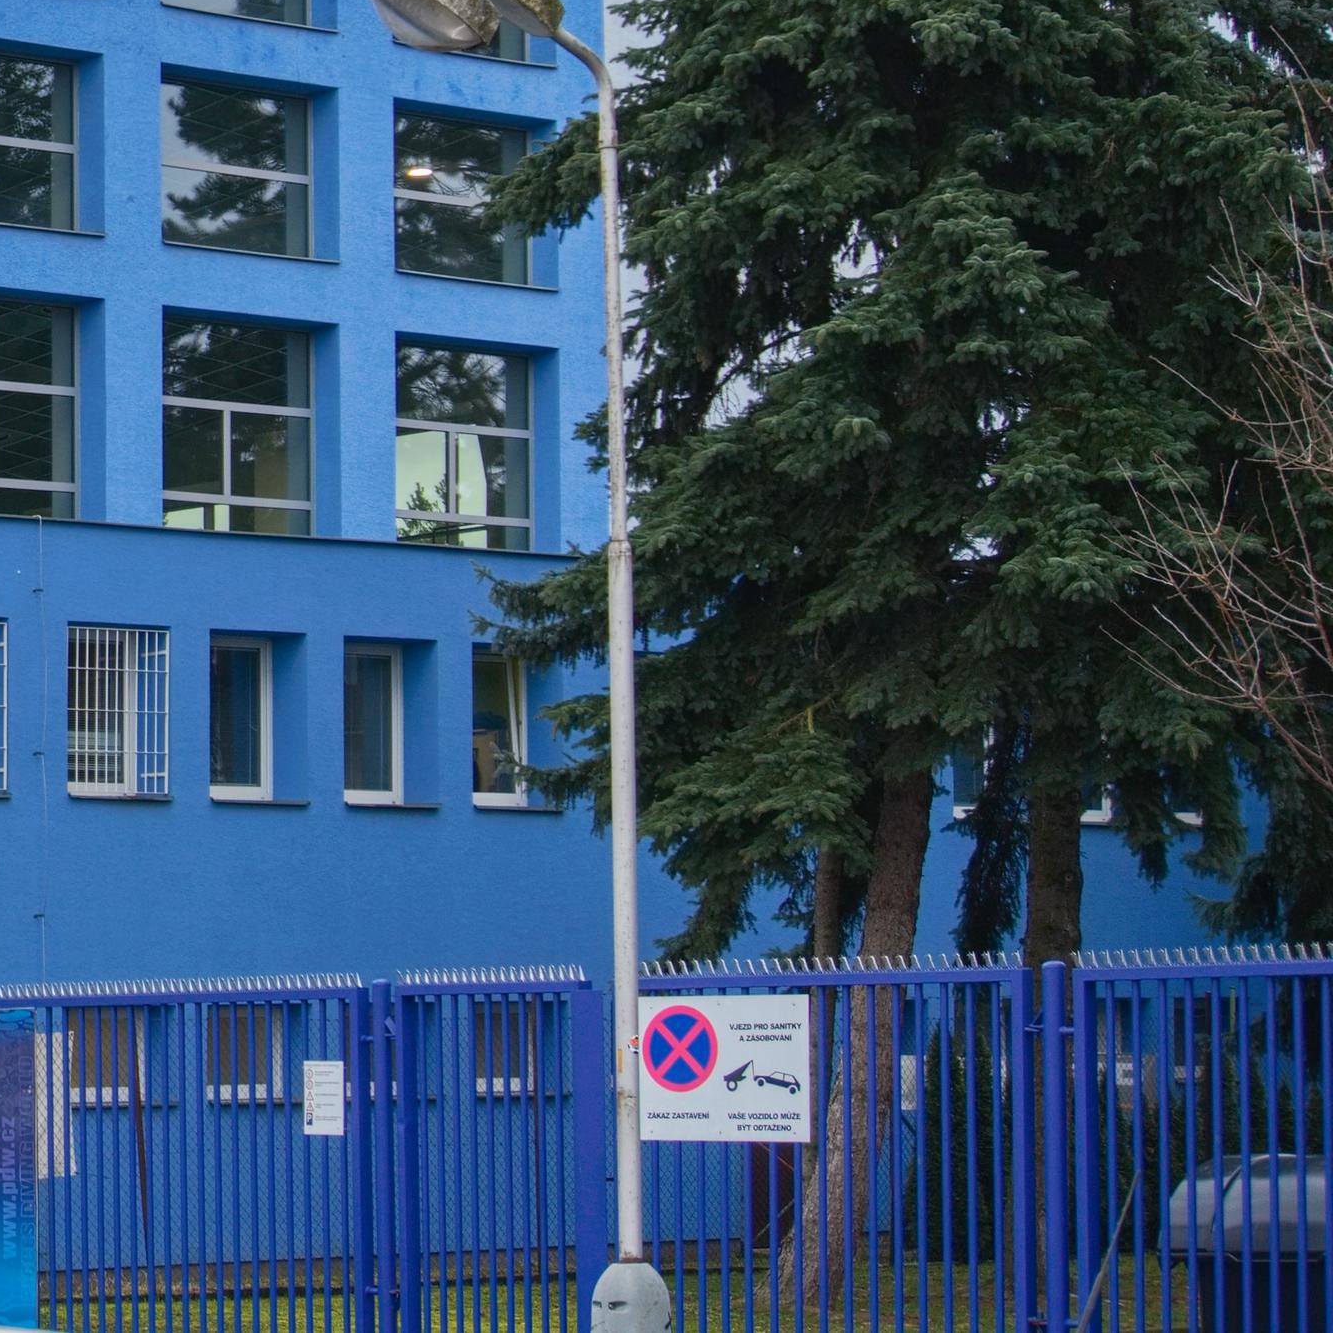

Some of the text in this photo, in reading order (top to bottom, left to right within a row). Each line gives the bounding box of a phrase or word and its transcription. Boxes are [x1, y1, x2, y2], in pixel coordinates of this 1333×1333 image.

[770, 1022, 802, 1030] SANITKY
[727, 1111, 746, 1120] VAŠE
[747, 1112, 779, 1120] VOZIDLO
[0, 1116, 19, 1260] www.pdw.cz
